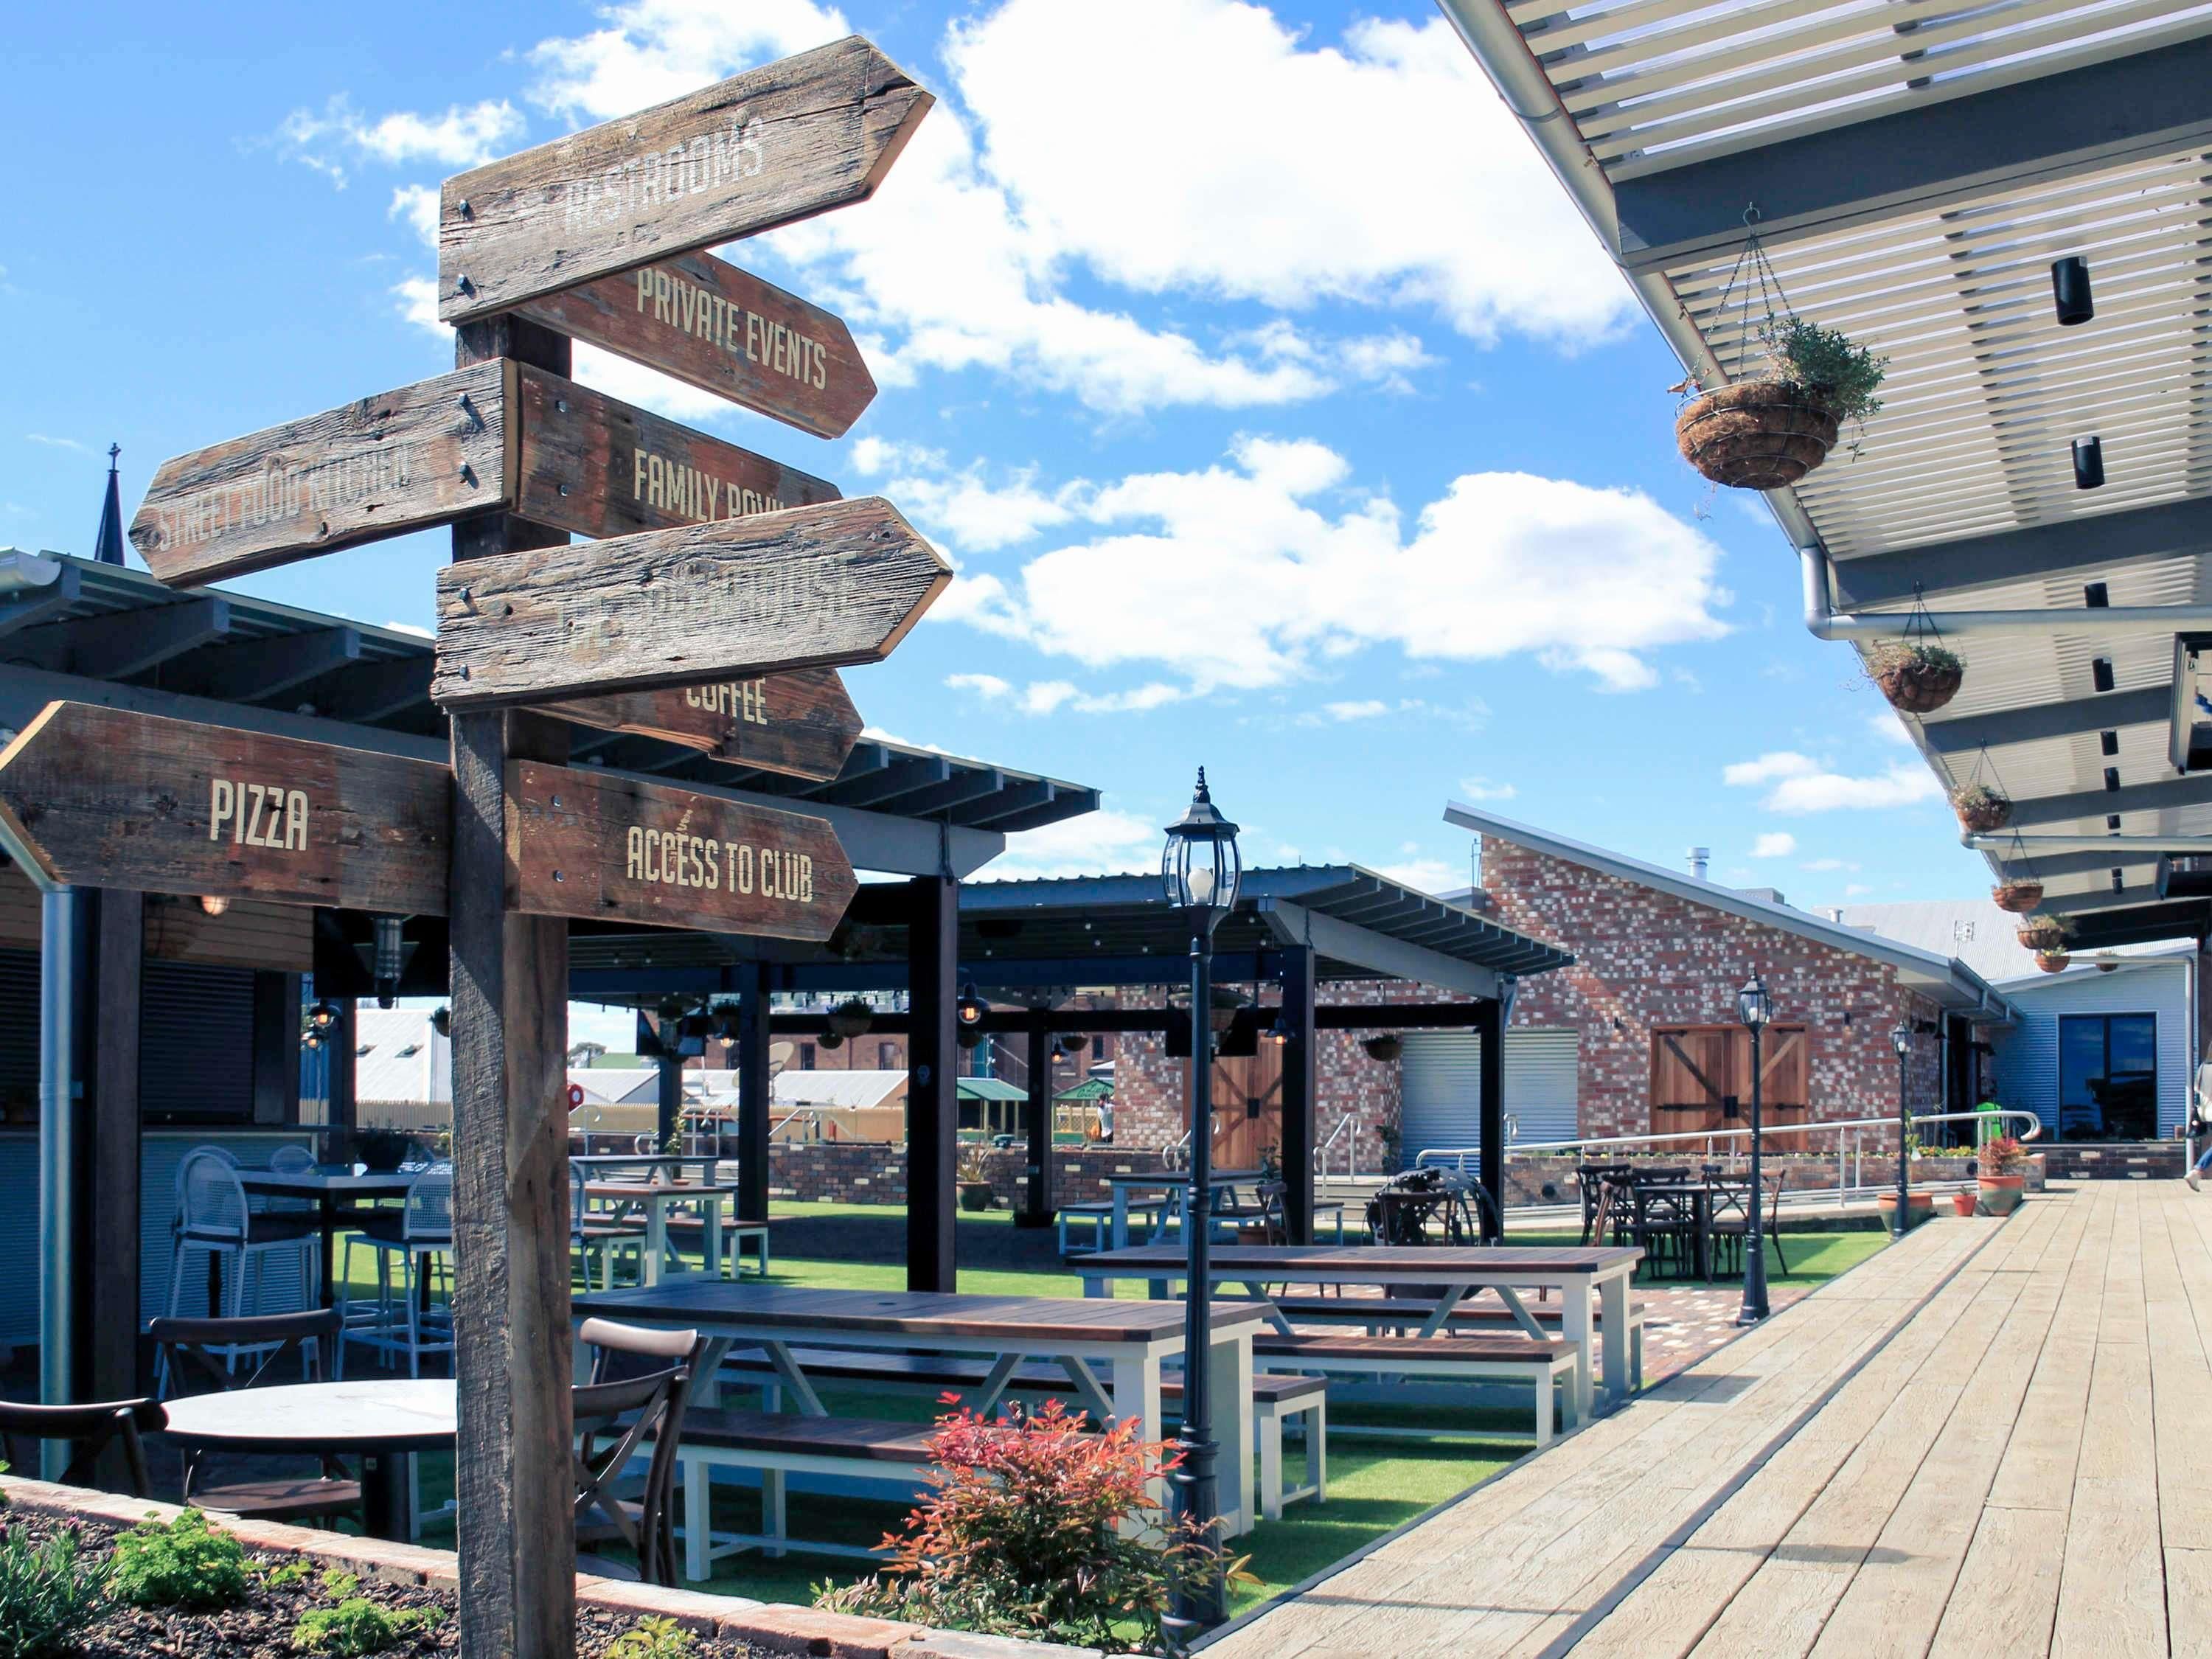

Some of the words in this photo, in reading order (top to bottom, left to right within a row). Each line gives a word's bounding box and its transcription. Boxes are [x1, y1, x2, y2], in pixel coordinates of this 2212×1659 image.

[565, 116, 765, 234] RESTROOMS
[637, 268, 739, 353] PRIVATE
[745, 310, 827, 390] EVENTS
[158, 485, 235, 551] STREET
[240, 466, 300, 528] FOOD
[633, 448, 720, 522] FAMILY
[209, 779, 308, 851] PIZZA
[627, 826, 719, 890] ACCESS
[726, 841, 754, 894] TO
[760, 848, 813, 902] CLUB
